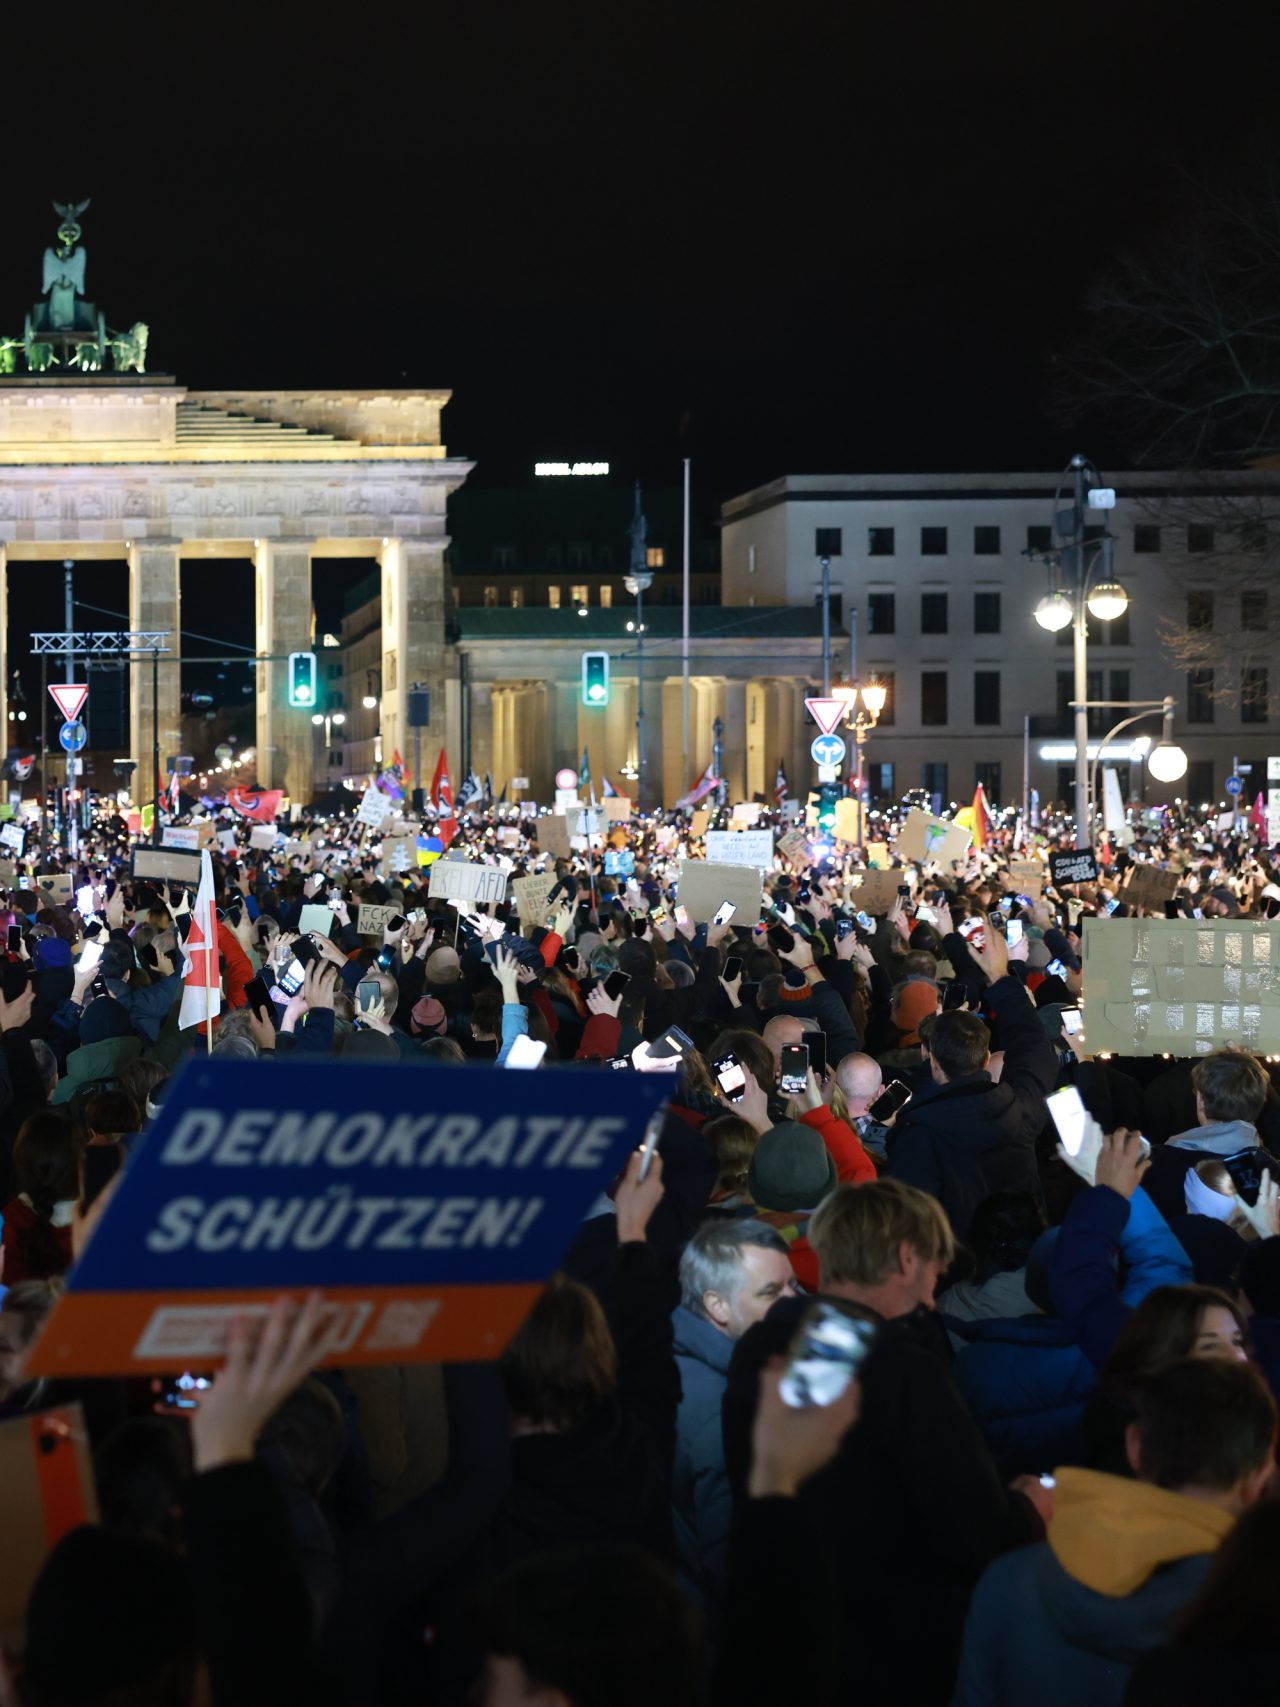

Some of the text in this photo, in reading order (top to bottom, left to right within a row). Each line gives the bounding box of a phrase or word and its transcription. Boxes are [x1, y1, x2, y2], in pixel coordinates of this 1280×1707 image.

[522, 879, 547, 890] LIEBER
[362, 906, 391, 921] FCK
[360, 921, 384, 933] NAZ
[158, 1108, 626, 1170] DEMOKRATIE
[146, 1185, 545, 1252] SCHÜTZEN!
